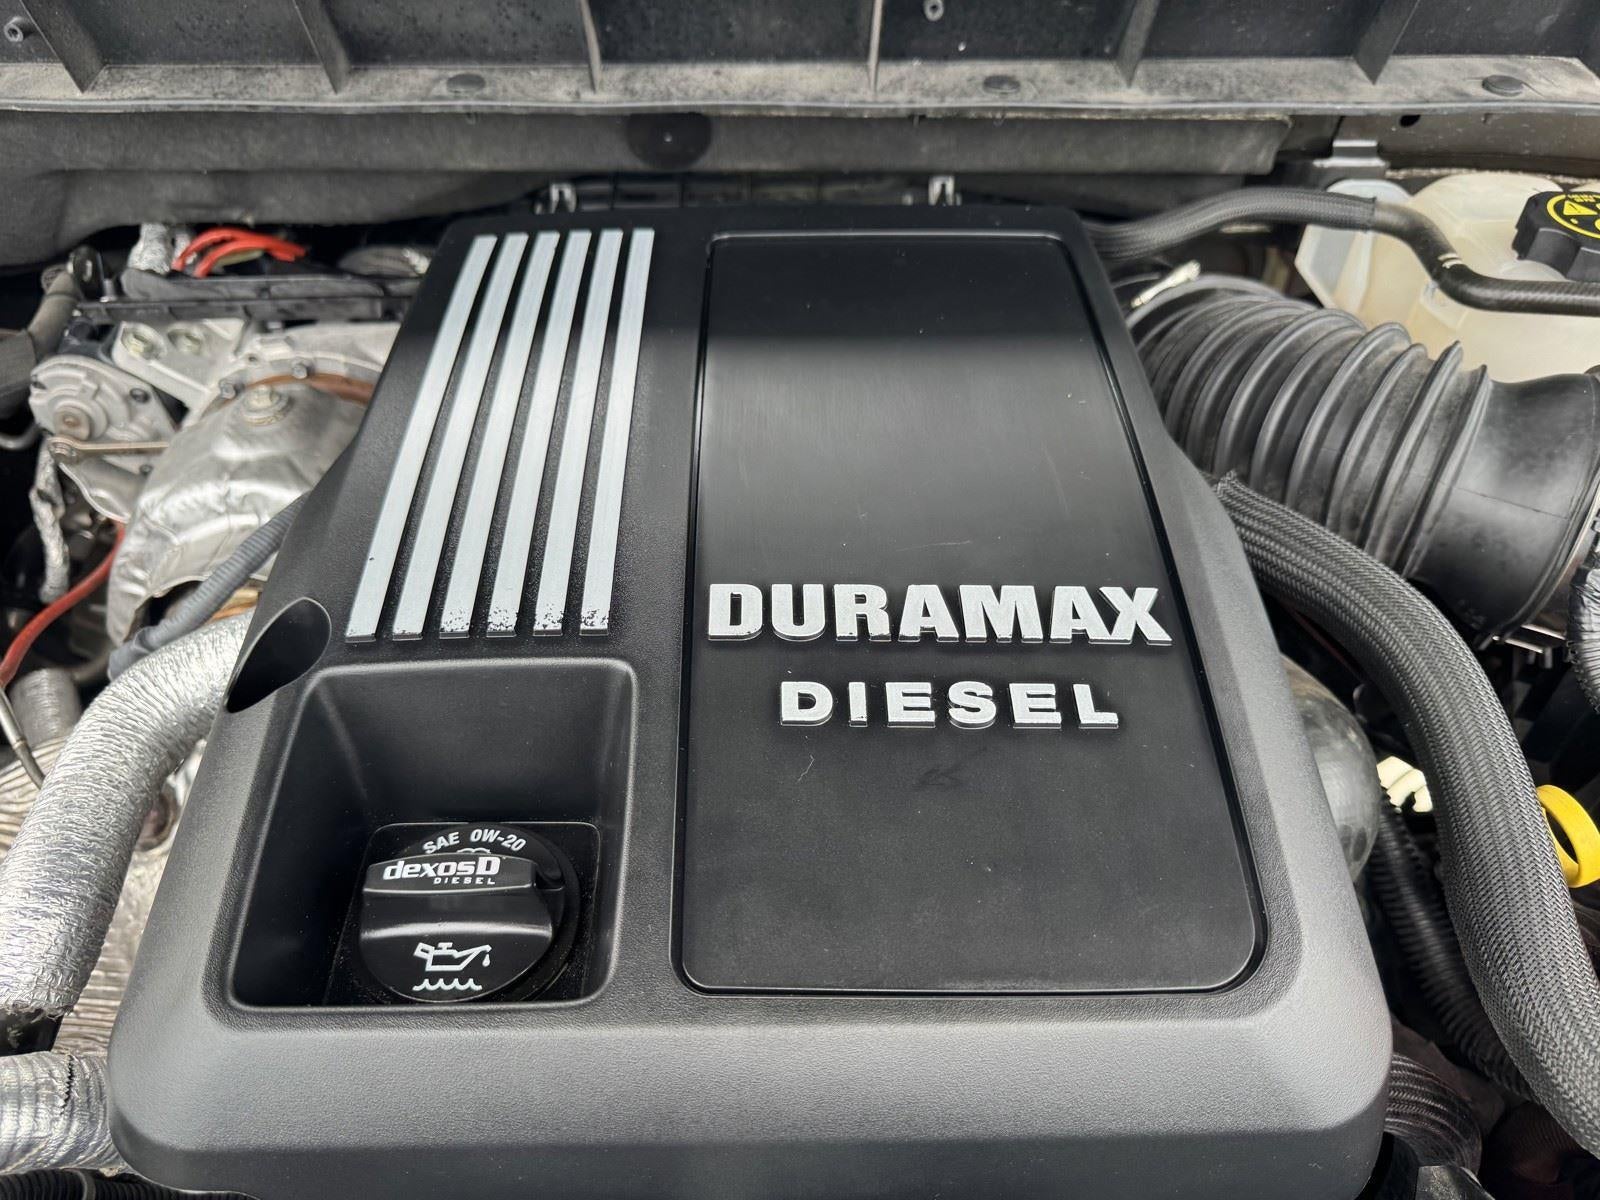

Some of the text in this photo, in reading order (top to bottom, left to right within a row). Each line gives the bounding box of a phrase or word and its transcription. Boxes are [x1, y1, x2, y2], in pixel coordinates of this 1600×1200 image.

[708, 583, 1173, 645] DURAMAX
[780, 680, 1119, 728] DIESEL
[422, 828, 526, 854] SAE 0W-20
[433, 876, 496, 885] DIESEL
